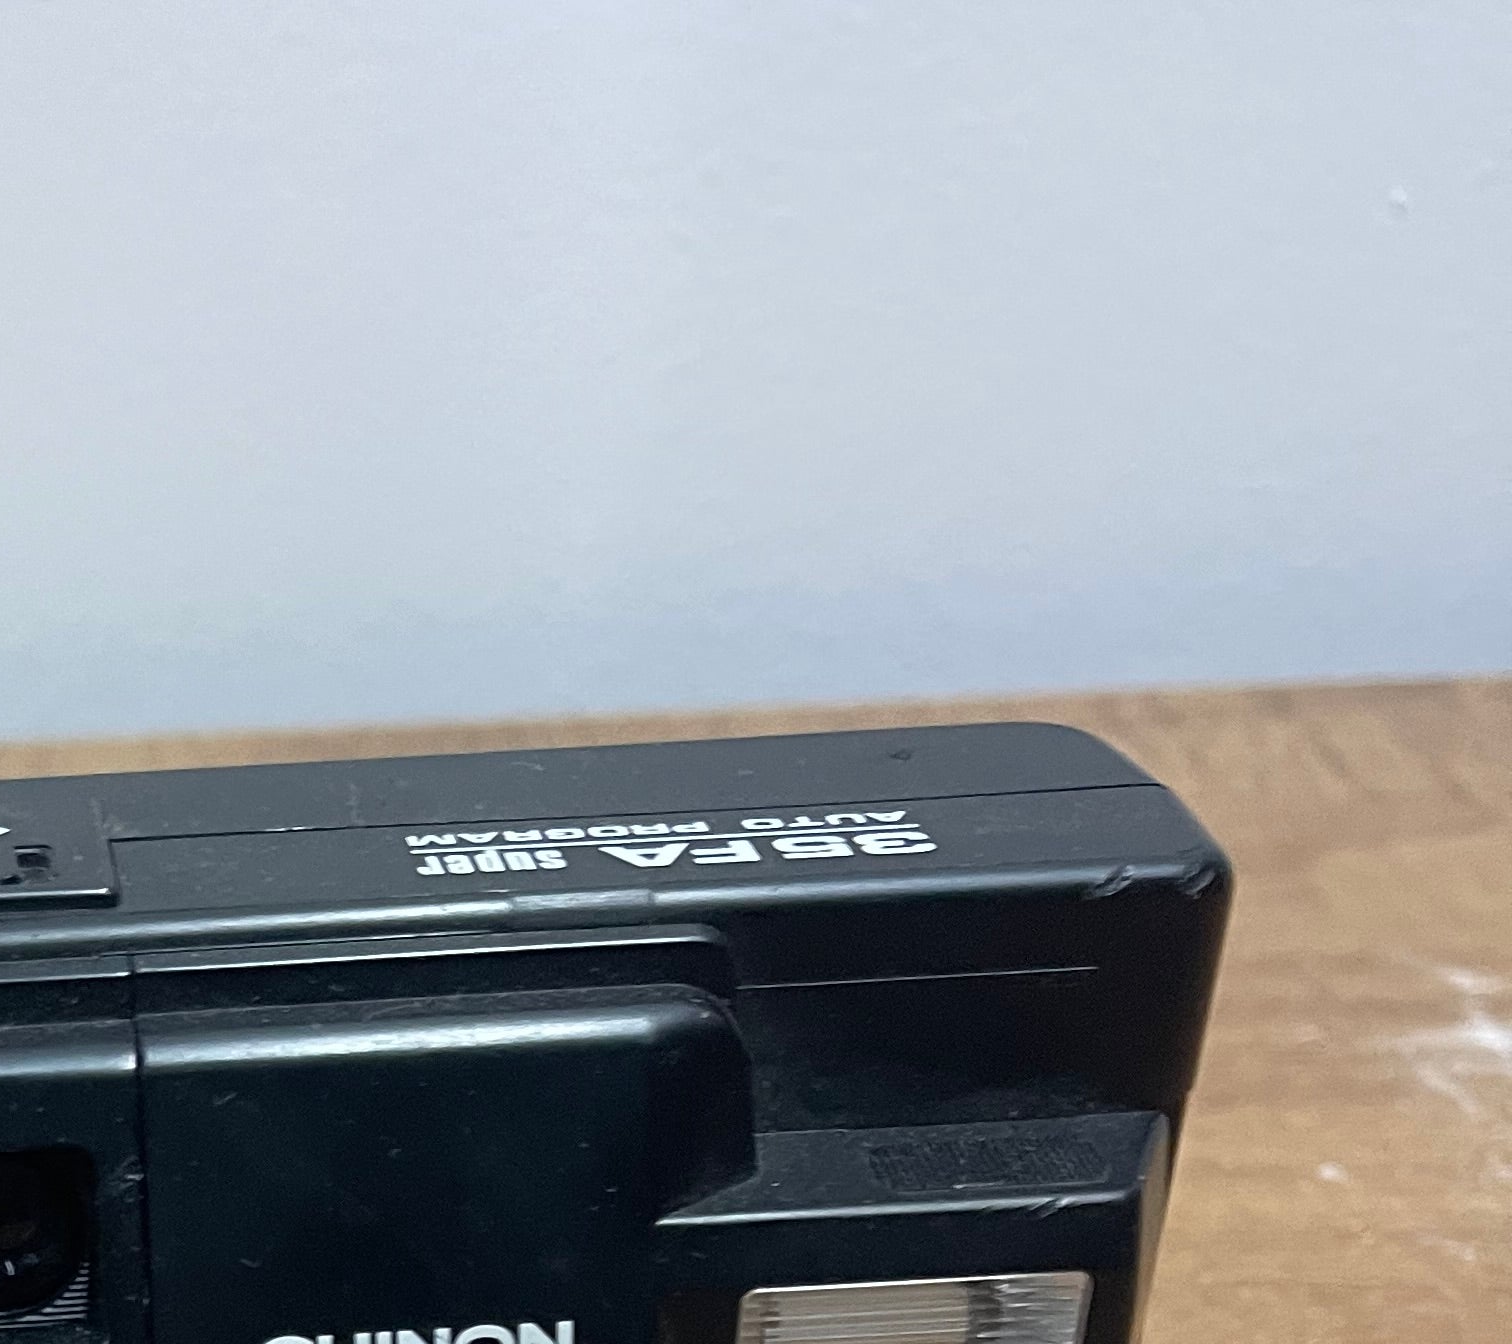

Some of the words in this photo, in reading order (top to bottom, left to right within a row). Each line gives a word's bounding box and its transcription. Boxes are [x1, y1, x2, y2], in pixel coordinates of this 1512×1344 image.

[739, 810, 907, 830] AUTO
[404, 821, 710, 847] PROGRAM
[416, 849, 568, 876] super
